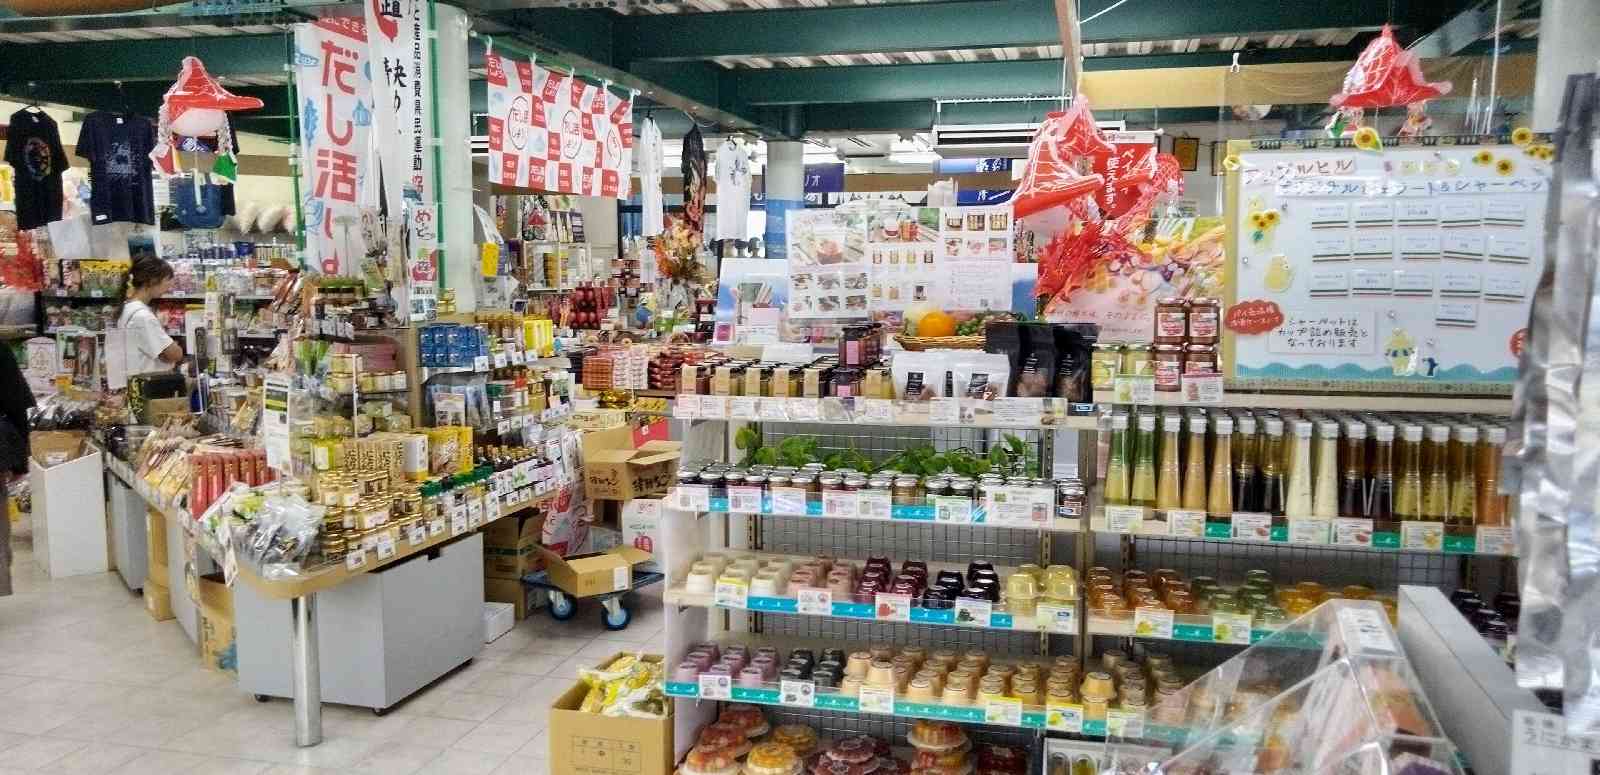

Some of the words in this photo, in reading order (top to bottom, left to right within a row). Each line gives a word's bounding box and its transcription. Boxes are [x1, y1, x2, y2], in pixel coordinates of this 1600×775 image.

[1288, 317, 1359, 327] シャーベットは
[1278, 327, 1369, 338] カップ詰め販売と
[1287, 338, 1360, 348] なっております
